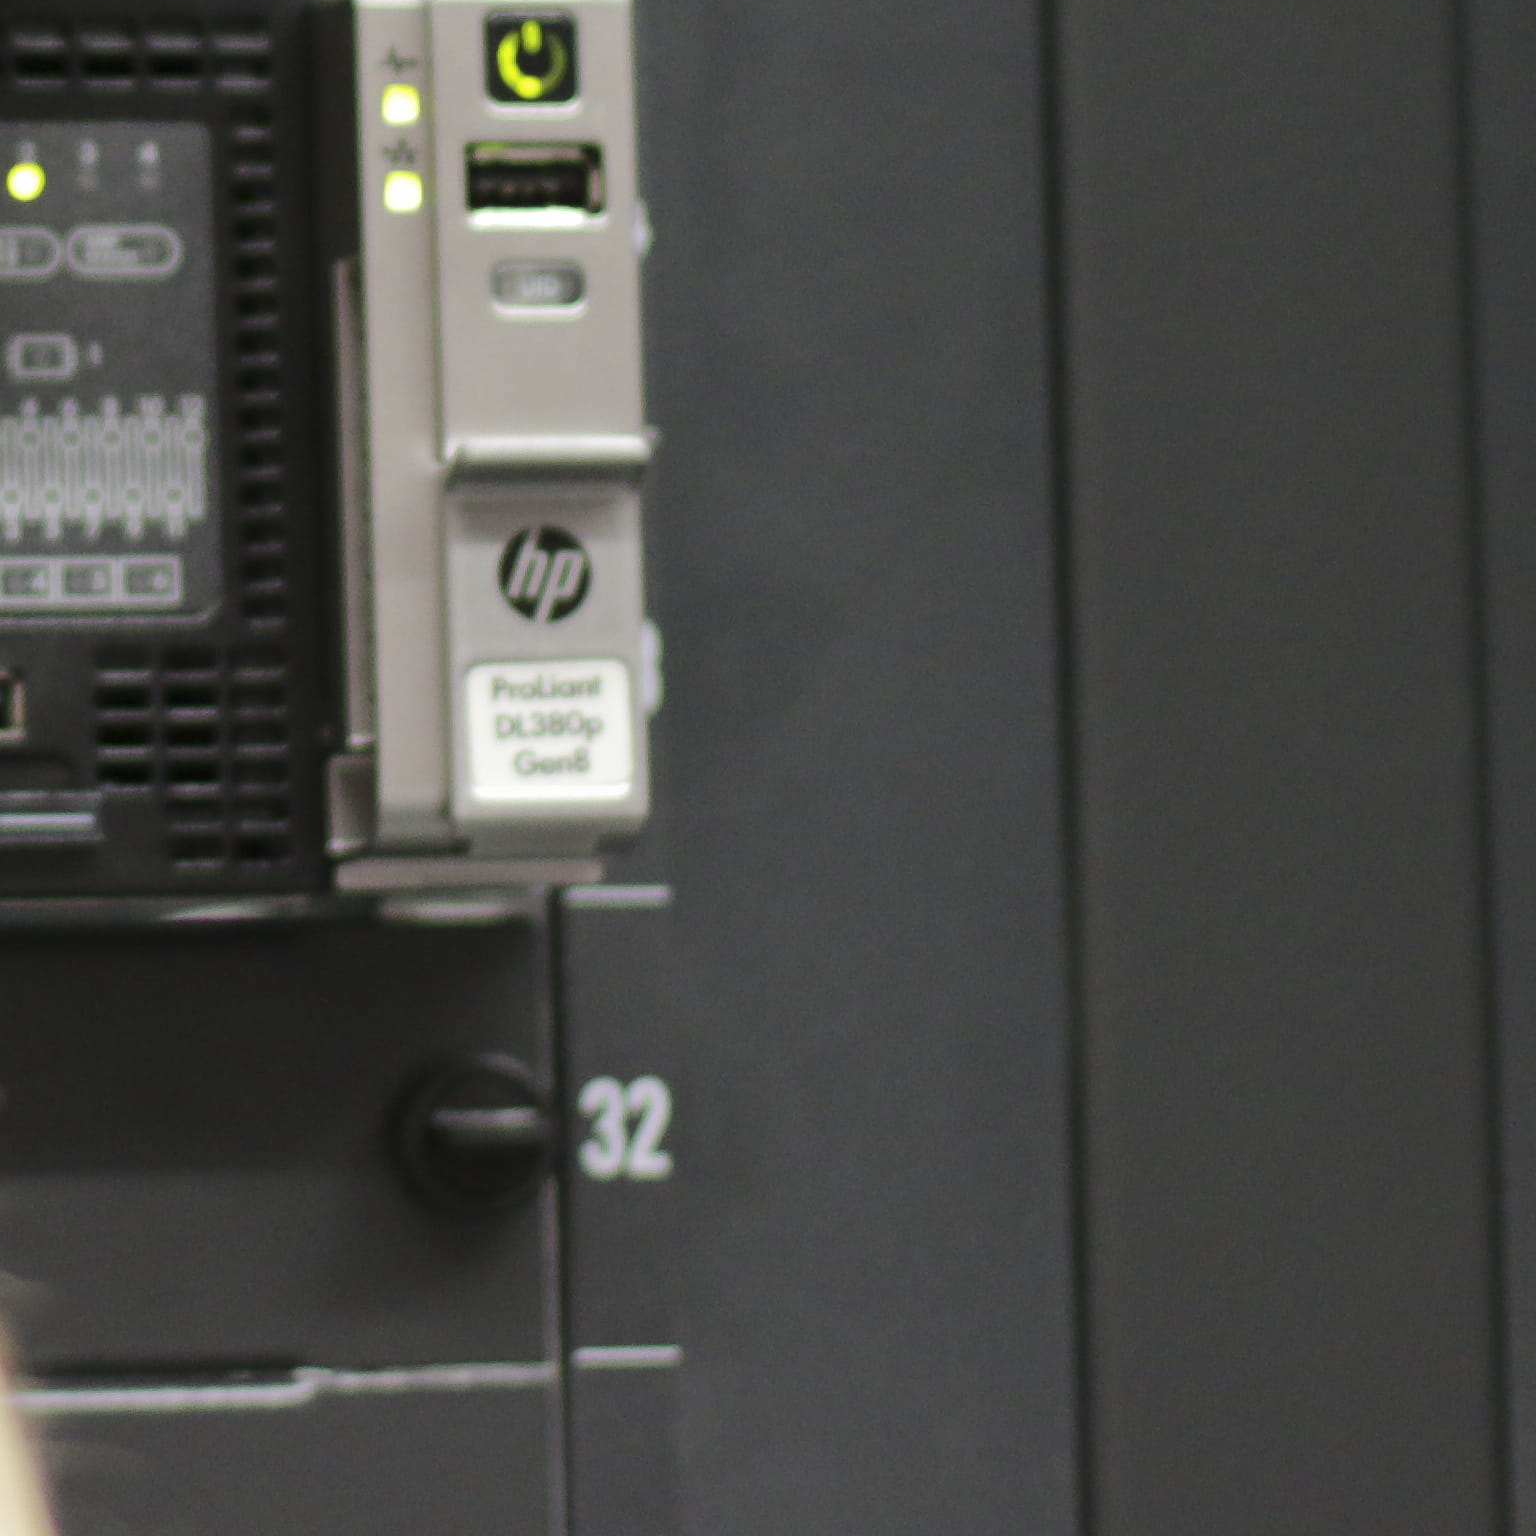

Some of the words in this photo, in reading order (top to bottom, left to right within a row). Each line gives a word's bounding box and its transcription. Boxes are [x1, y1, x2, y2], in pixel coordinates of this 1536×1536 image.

[502, 526, 588, 622] hp
[492, 677, 601, 701] ProLiant
[495, 713, 604, 740] DL380p
[514, 751, 589, 776] Gen8
[578, 1076, 672, 1181] 32
